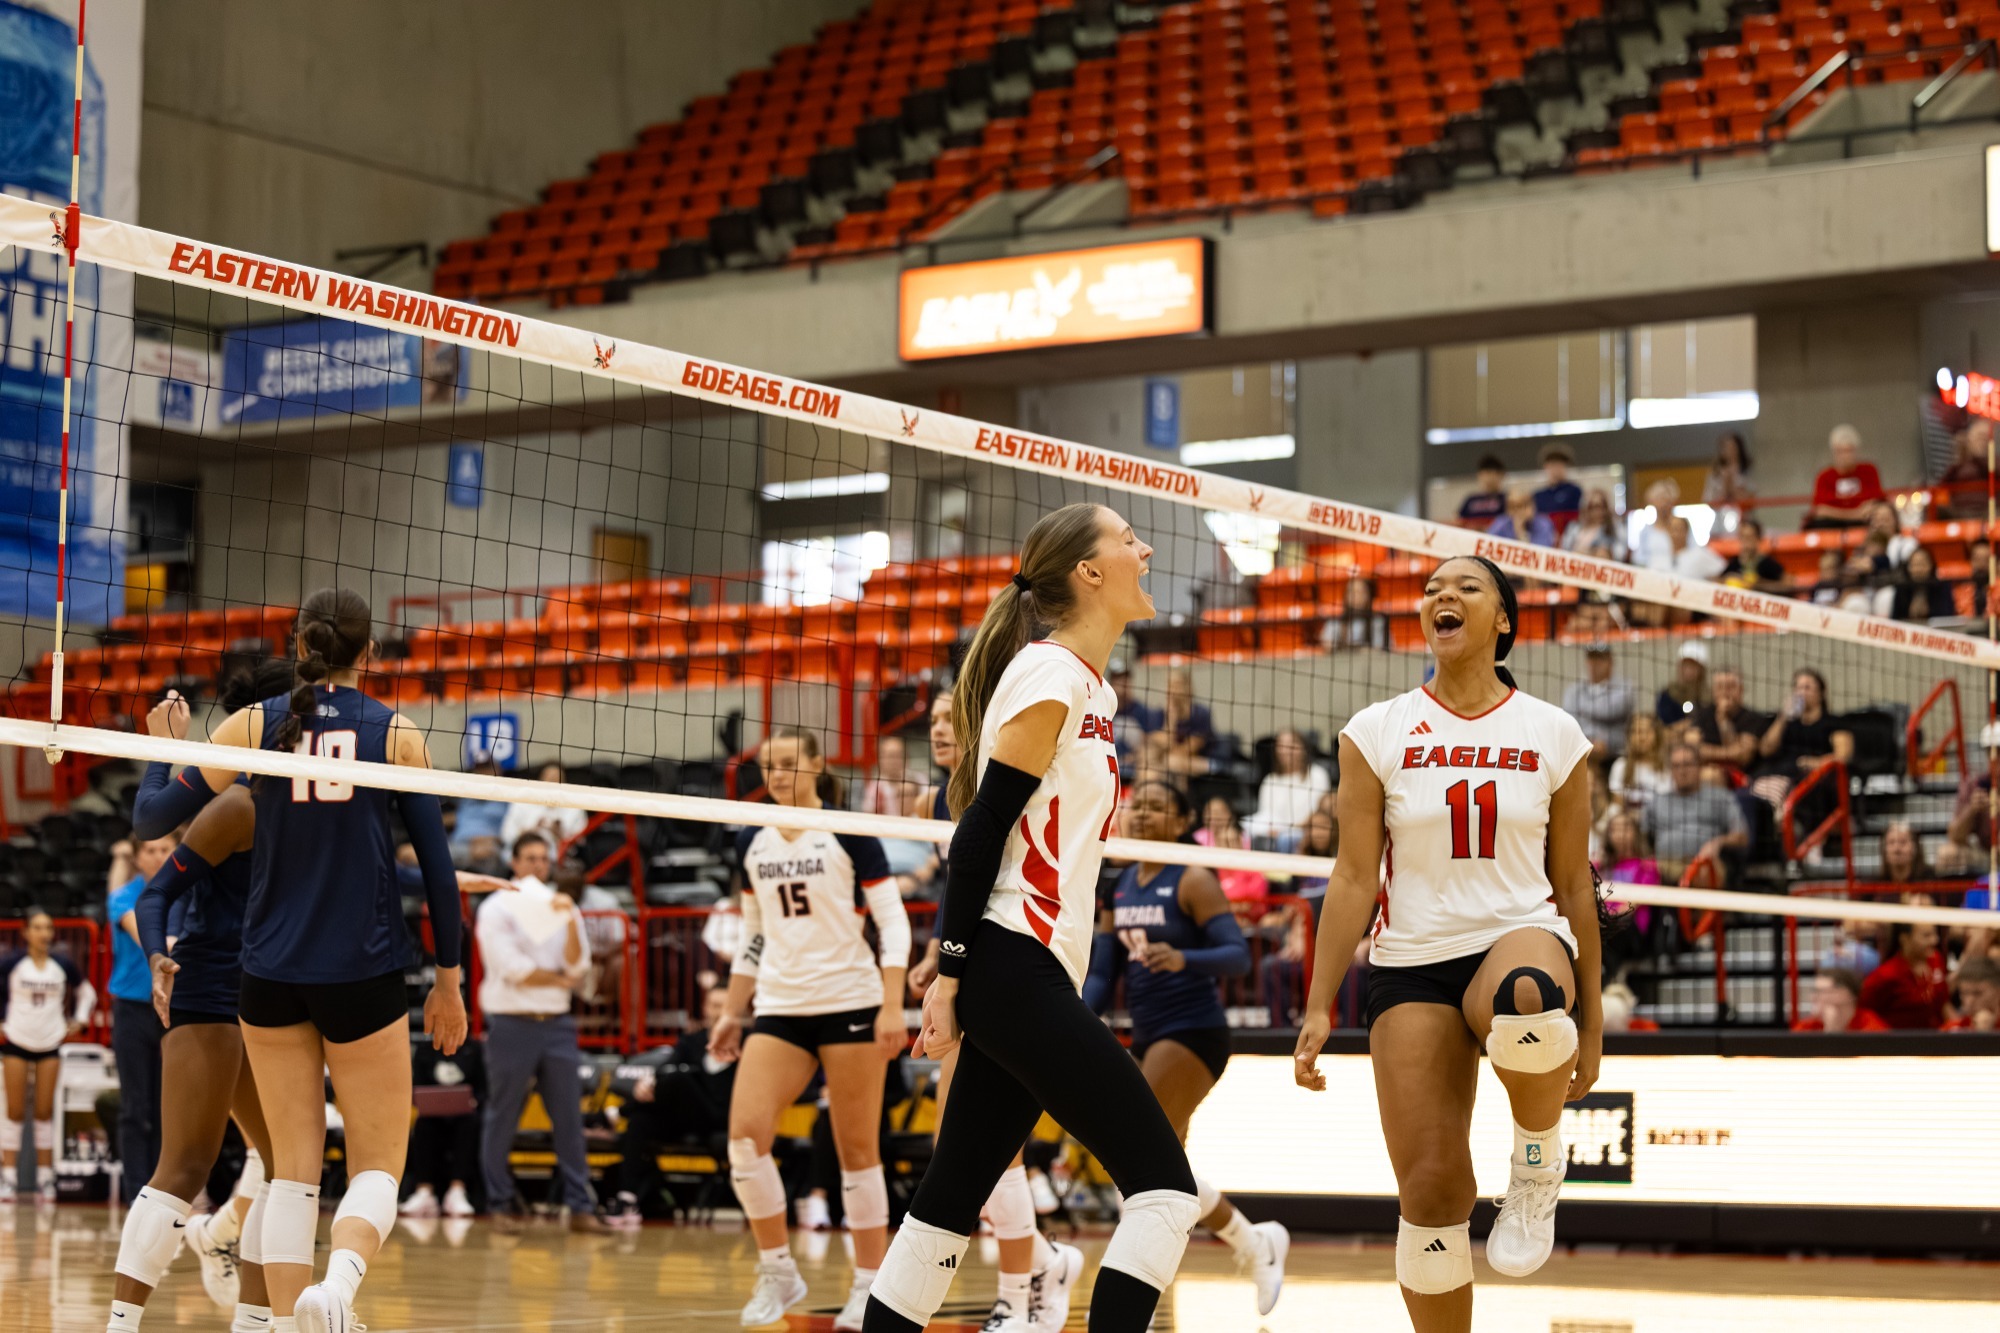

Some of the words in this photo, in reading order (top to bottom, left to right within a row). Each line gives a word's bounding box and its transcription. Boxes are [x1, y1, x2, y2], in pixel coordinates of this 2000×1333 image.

[168, 241, 320, 302] EASTERN
[326, 277, 522, 348] WASHINGTON
[681, 360, 842, 419] GOEAGS.COM
[975, 427, 1070, 469] EASTERN
[1074, 449, 1203, 498] WASHINGTON
[1475, 538, 1539, 573] EASTERN
[1544, 552, 1636, 590] WASHINGTON
[1401, 745, 1539, 772] EAGLES
[1099, 755, 1121, 842] 7
[1445, 779, 1498, 859] 11
[758, 859, 826, 879] GONZAGA
[777, 882, 812, 918] 15
